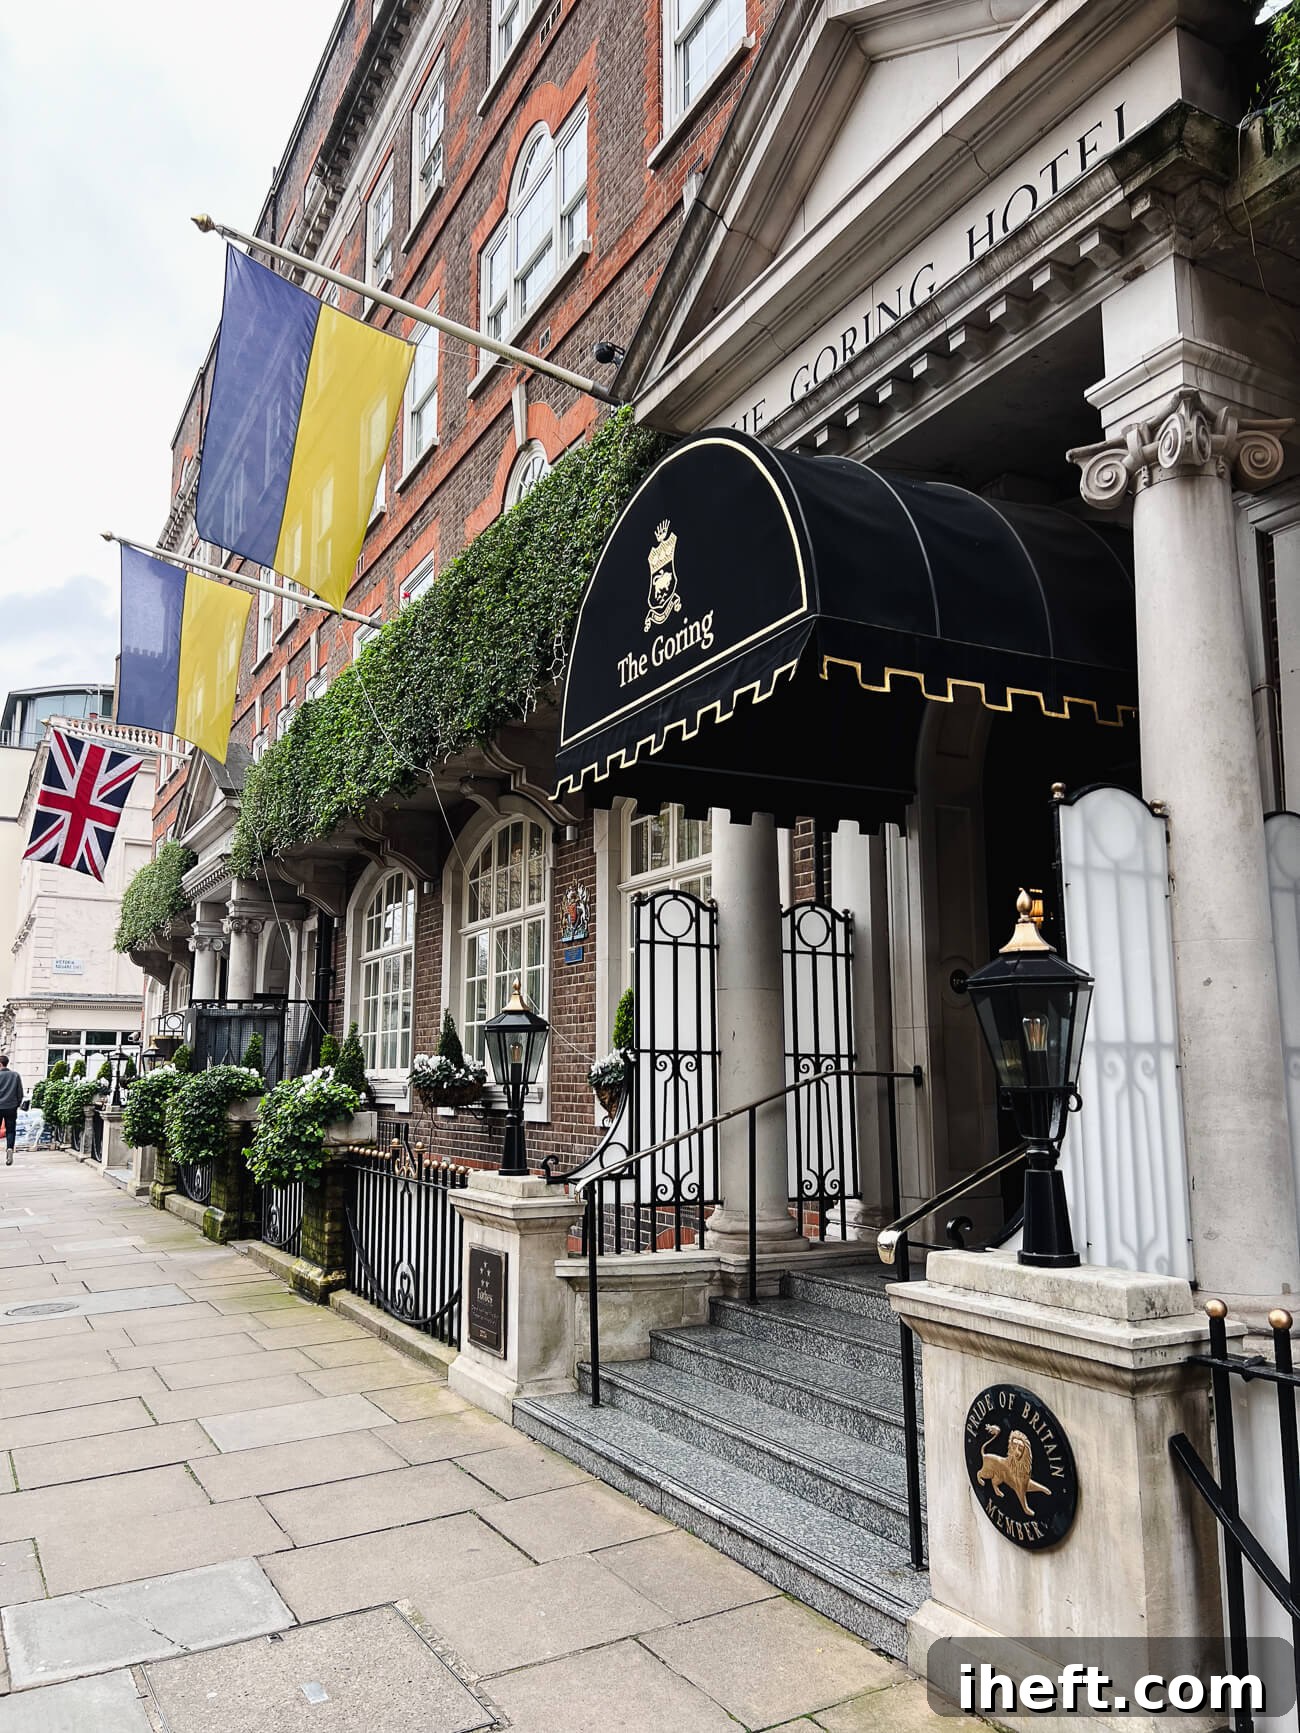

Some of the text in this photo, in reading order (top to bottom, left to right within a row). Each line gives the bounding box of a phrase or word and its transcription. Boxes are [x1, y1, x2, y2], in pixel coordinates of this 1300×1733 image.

[789, 262, 937, 403] GORING
[617, 608, 714, 688] The Goring
[966, 1391, 1065, 1479] PRIDE OF BRITAIN
[985, 1498, 1044, 1542] MEMBER
